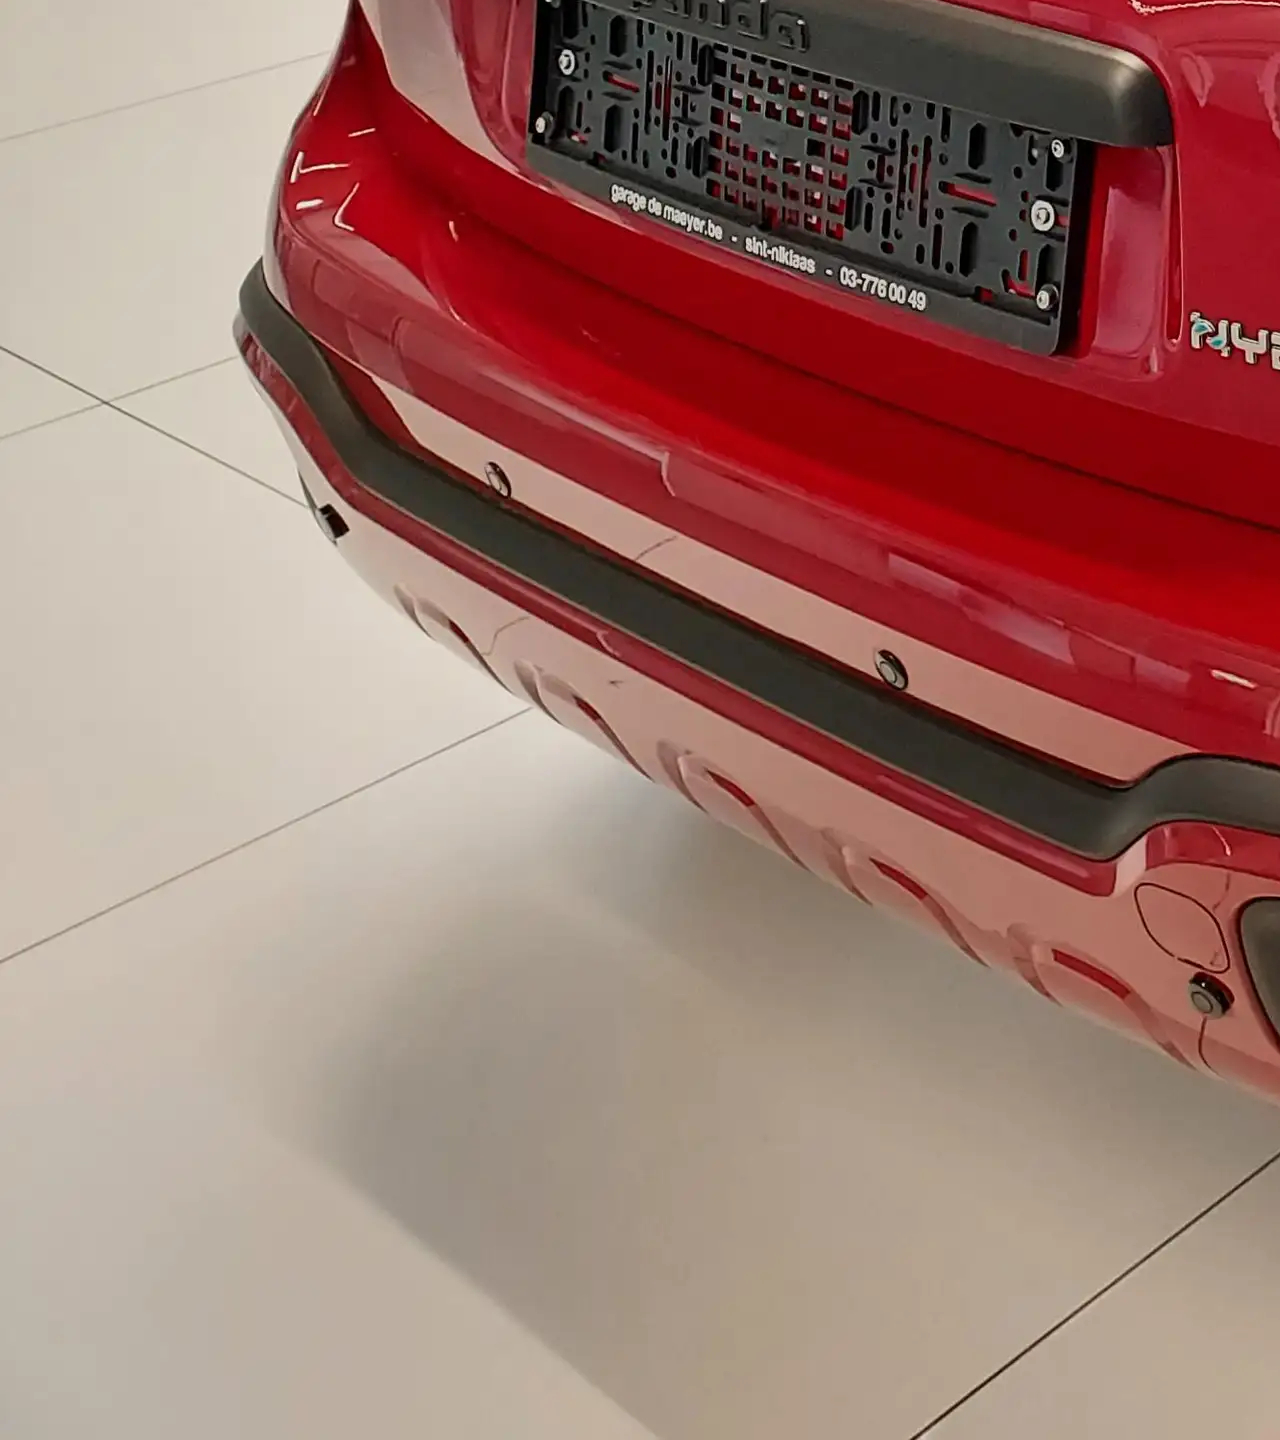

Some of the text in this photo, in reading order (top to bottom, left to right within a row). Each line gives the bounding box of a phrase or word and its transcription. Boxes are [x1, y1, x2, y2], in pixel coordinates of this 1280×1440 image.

[611, 183, 647, 212] garage
[648, 197, 662, 217] de
[663, 204, 723, 242] maeyer.be
[839, 265, 887, 299] 03-776
[888, 284, 906, 306] 00
[907, 289, 927, 311] 49
